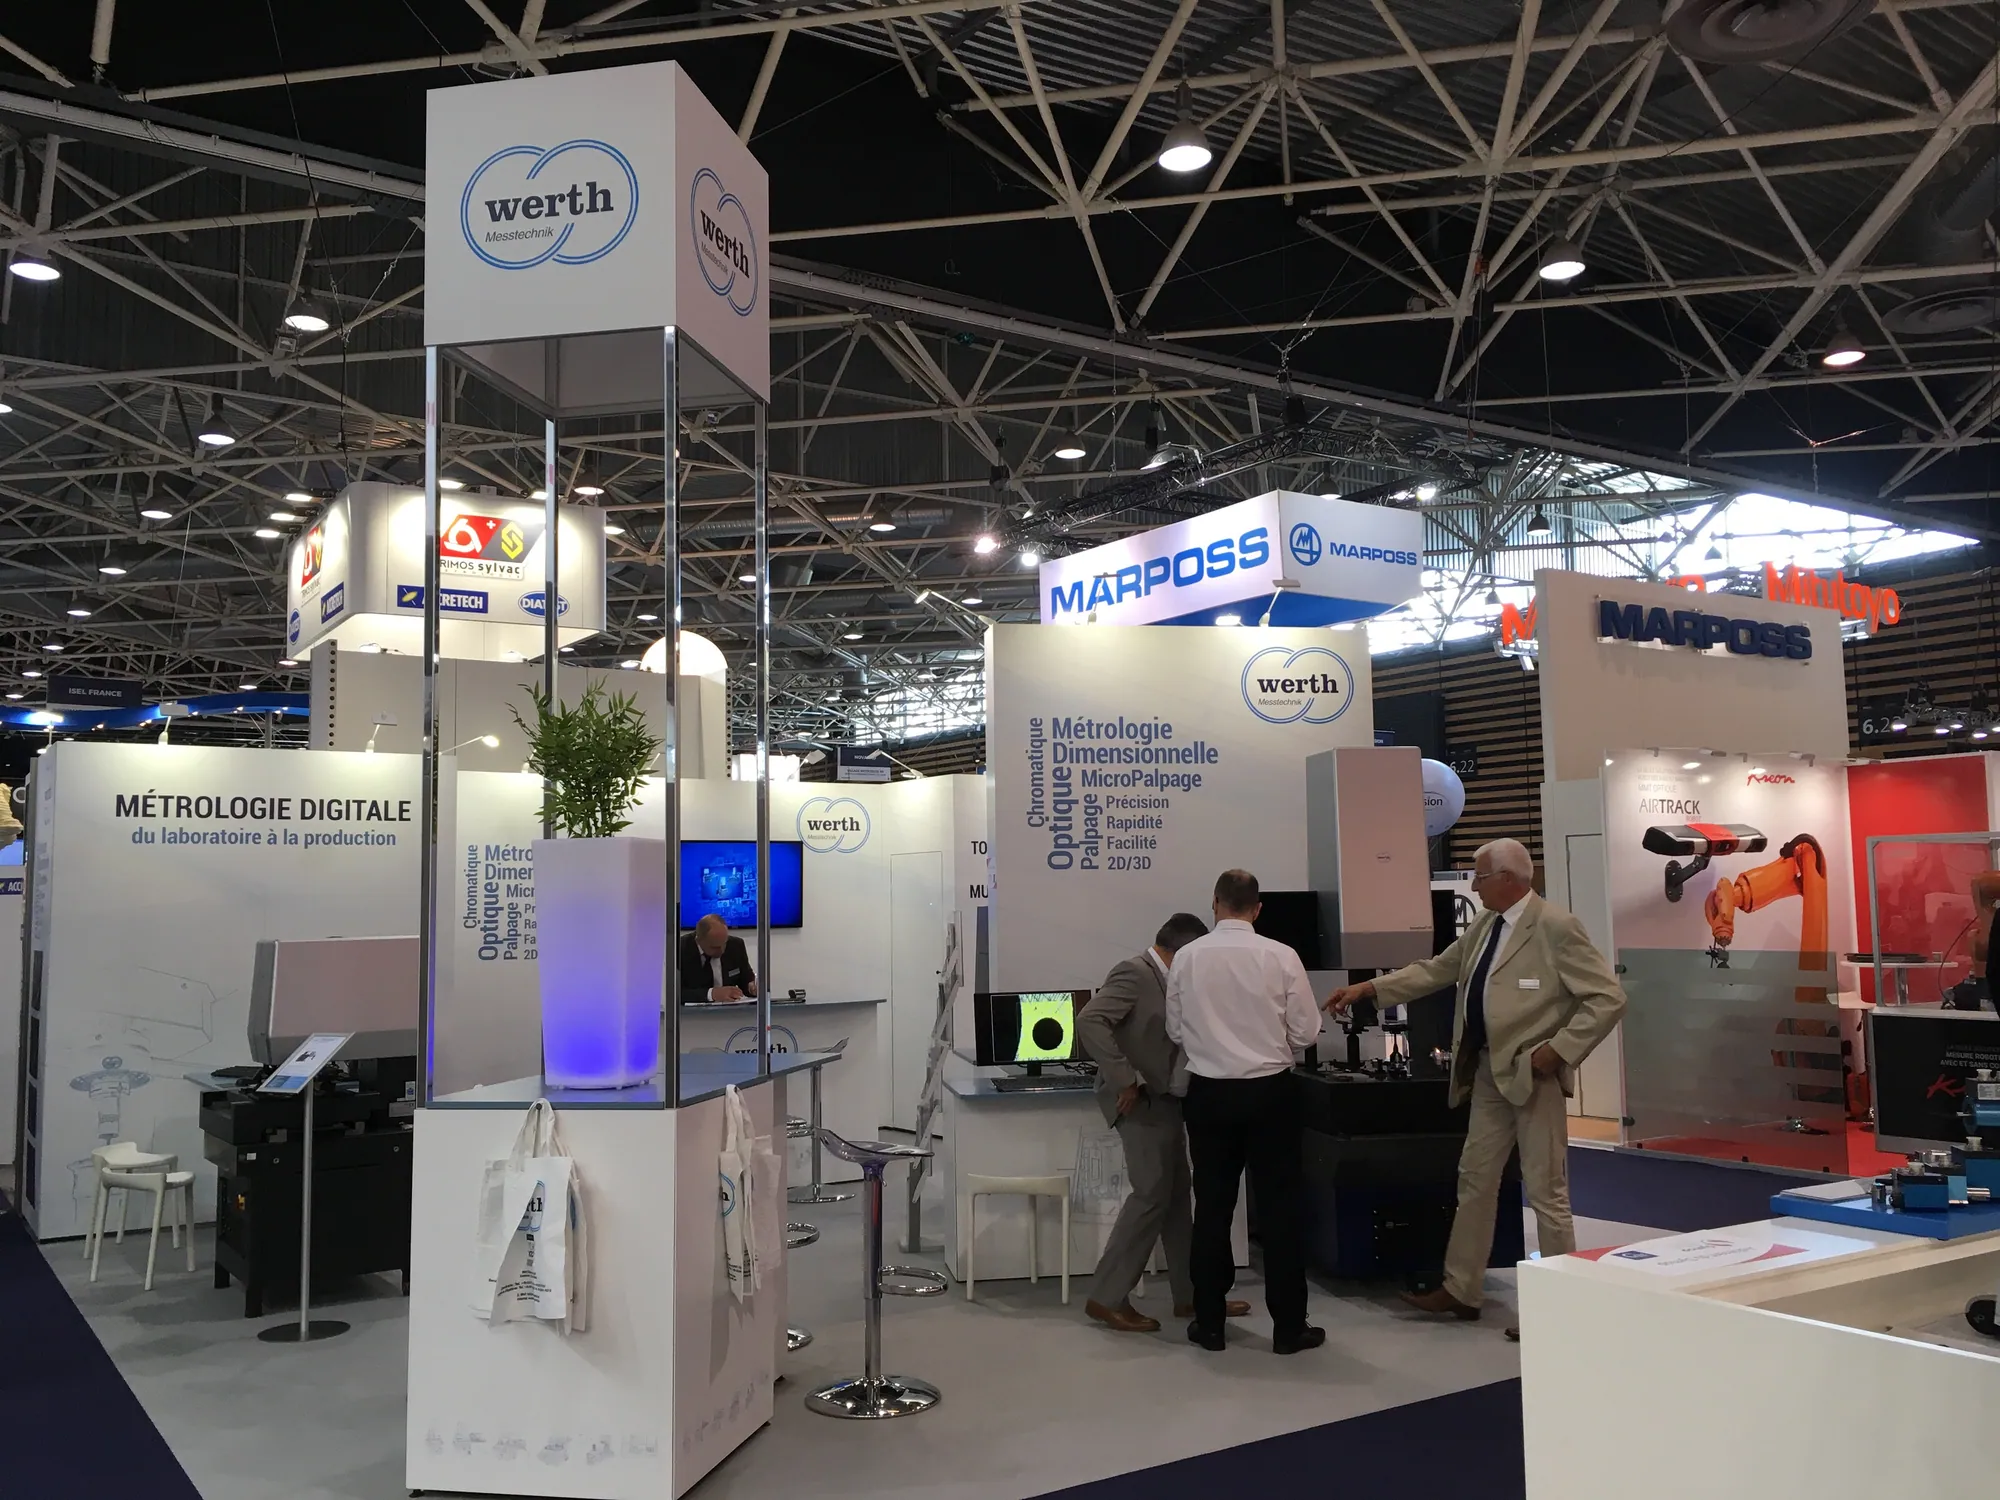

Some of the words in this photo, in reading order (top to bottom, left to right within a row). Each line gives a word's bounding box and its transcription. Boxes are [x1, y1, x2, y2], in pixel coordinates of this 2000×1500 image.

[485, 181, 614, 223] werth
[484, 226, 554, 243] Messtechnik
[700, 209, 750, 279] werth
[1329, 541, 1418, 566] MARPOSS
[440, 559, 475, 571] RIMOS
[478, 562, 520, 574] sylvac
[1051, 526, 1271, 618] MARPOSS
[1600, 599, 1813, 660] MARPOSS
[68, 687, 86, 696] ISEL
[88, 688, 123, 698] FRANCE
[1257, 673, 1340, 694] werth
[1257, 697, 1303, 708] Messtechnik
[1052, 716, 1173, 745] Métrologie
[1052, 740, 1219, 765] Dimensionnelle
[1026, 717, 1048, 828] Chromatique
[1081, 767, 1202, 792] MicroPalpage
[115, 788, 292, 820] MÉTROLOGIE
[300, 798, 412, 822] DIGITALE
[1106, 794, 1169, 810] Précision
[1638, 798, 1701, 815] AIRTRACK
[807, 816, 861, 832] werth
[1045, 766, 1080, 870] Optique
[1106, 814, 1163, 832] Rapidité
[131, 826, 156, 846] du
[161, 827, 262, 847] laboratoire
[266, 828, 278, 846] à
[283, 828, 299, 846] la
[303, 829, 397, 849] production
[1078, 793, 1103, 870] Palpage
[1107, 834, 1157, 850] Facilité
[1107, 855, 1152, 872] 2D/3D
[463, 844, 481, 929] Chromatique
[478, 881, 505, 961] Optique
[503, 902, 523, 961] Palpage
